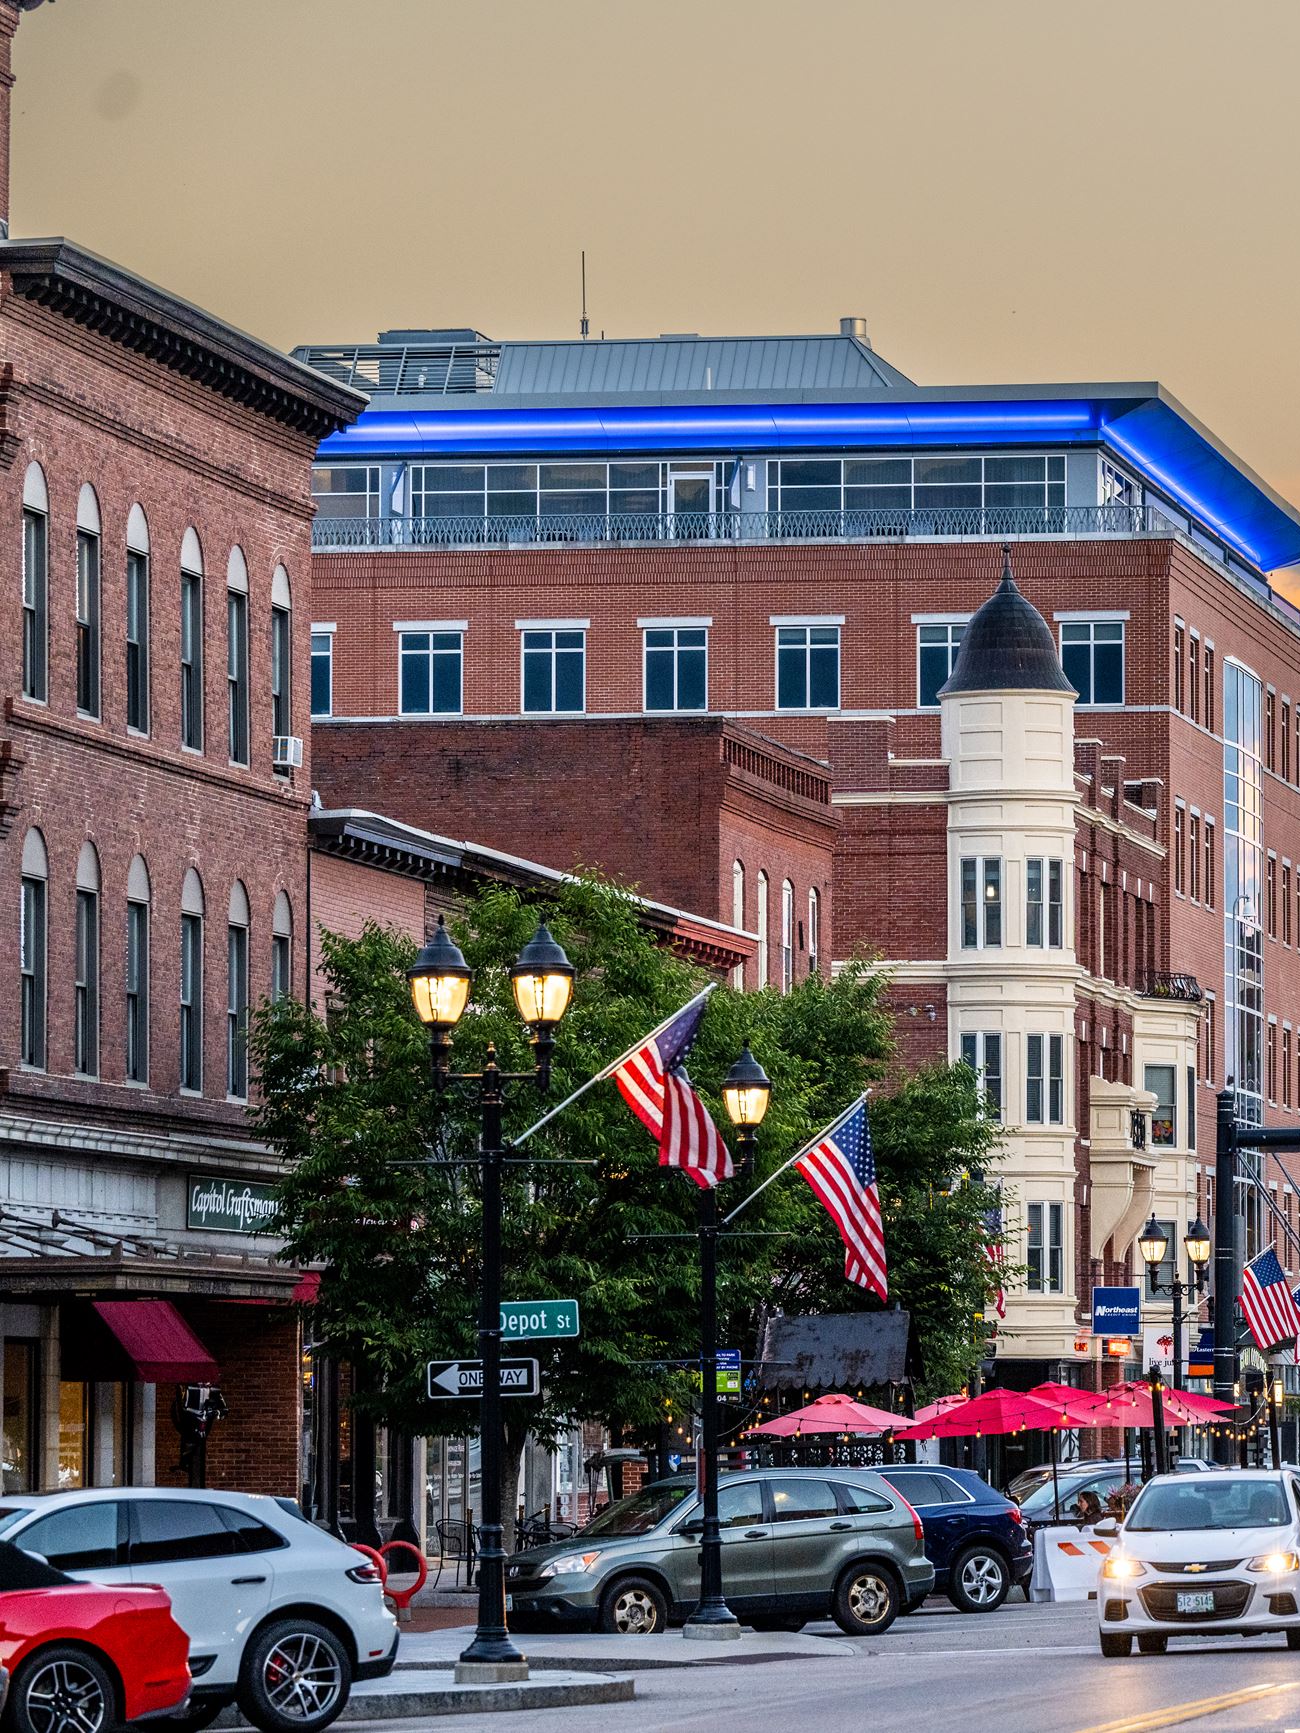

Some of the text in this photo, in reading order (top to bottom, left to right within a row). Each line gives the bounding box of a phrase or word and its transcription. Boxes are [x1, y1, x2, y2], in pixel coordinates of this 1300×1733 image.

[192, 1182, 226, 1223] Capitol
[1094, 1305, 1138, 1316] Northeast
[557, 1314, 571, 1329] St
[1149, 1358, 1163, 1366] live
[459, 1372, 484, 1386] ONE
